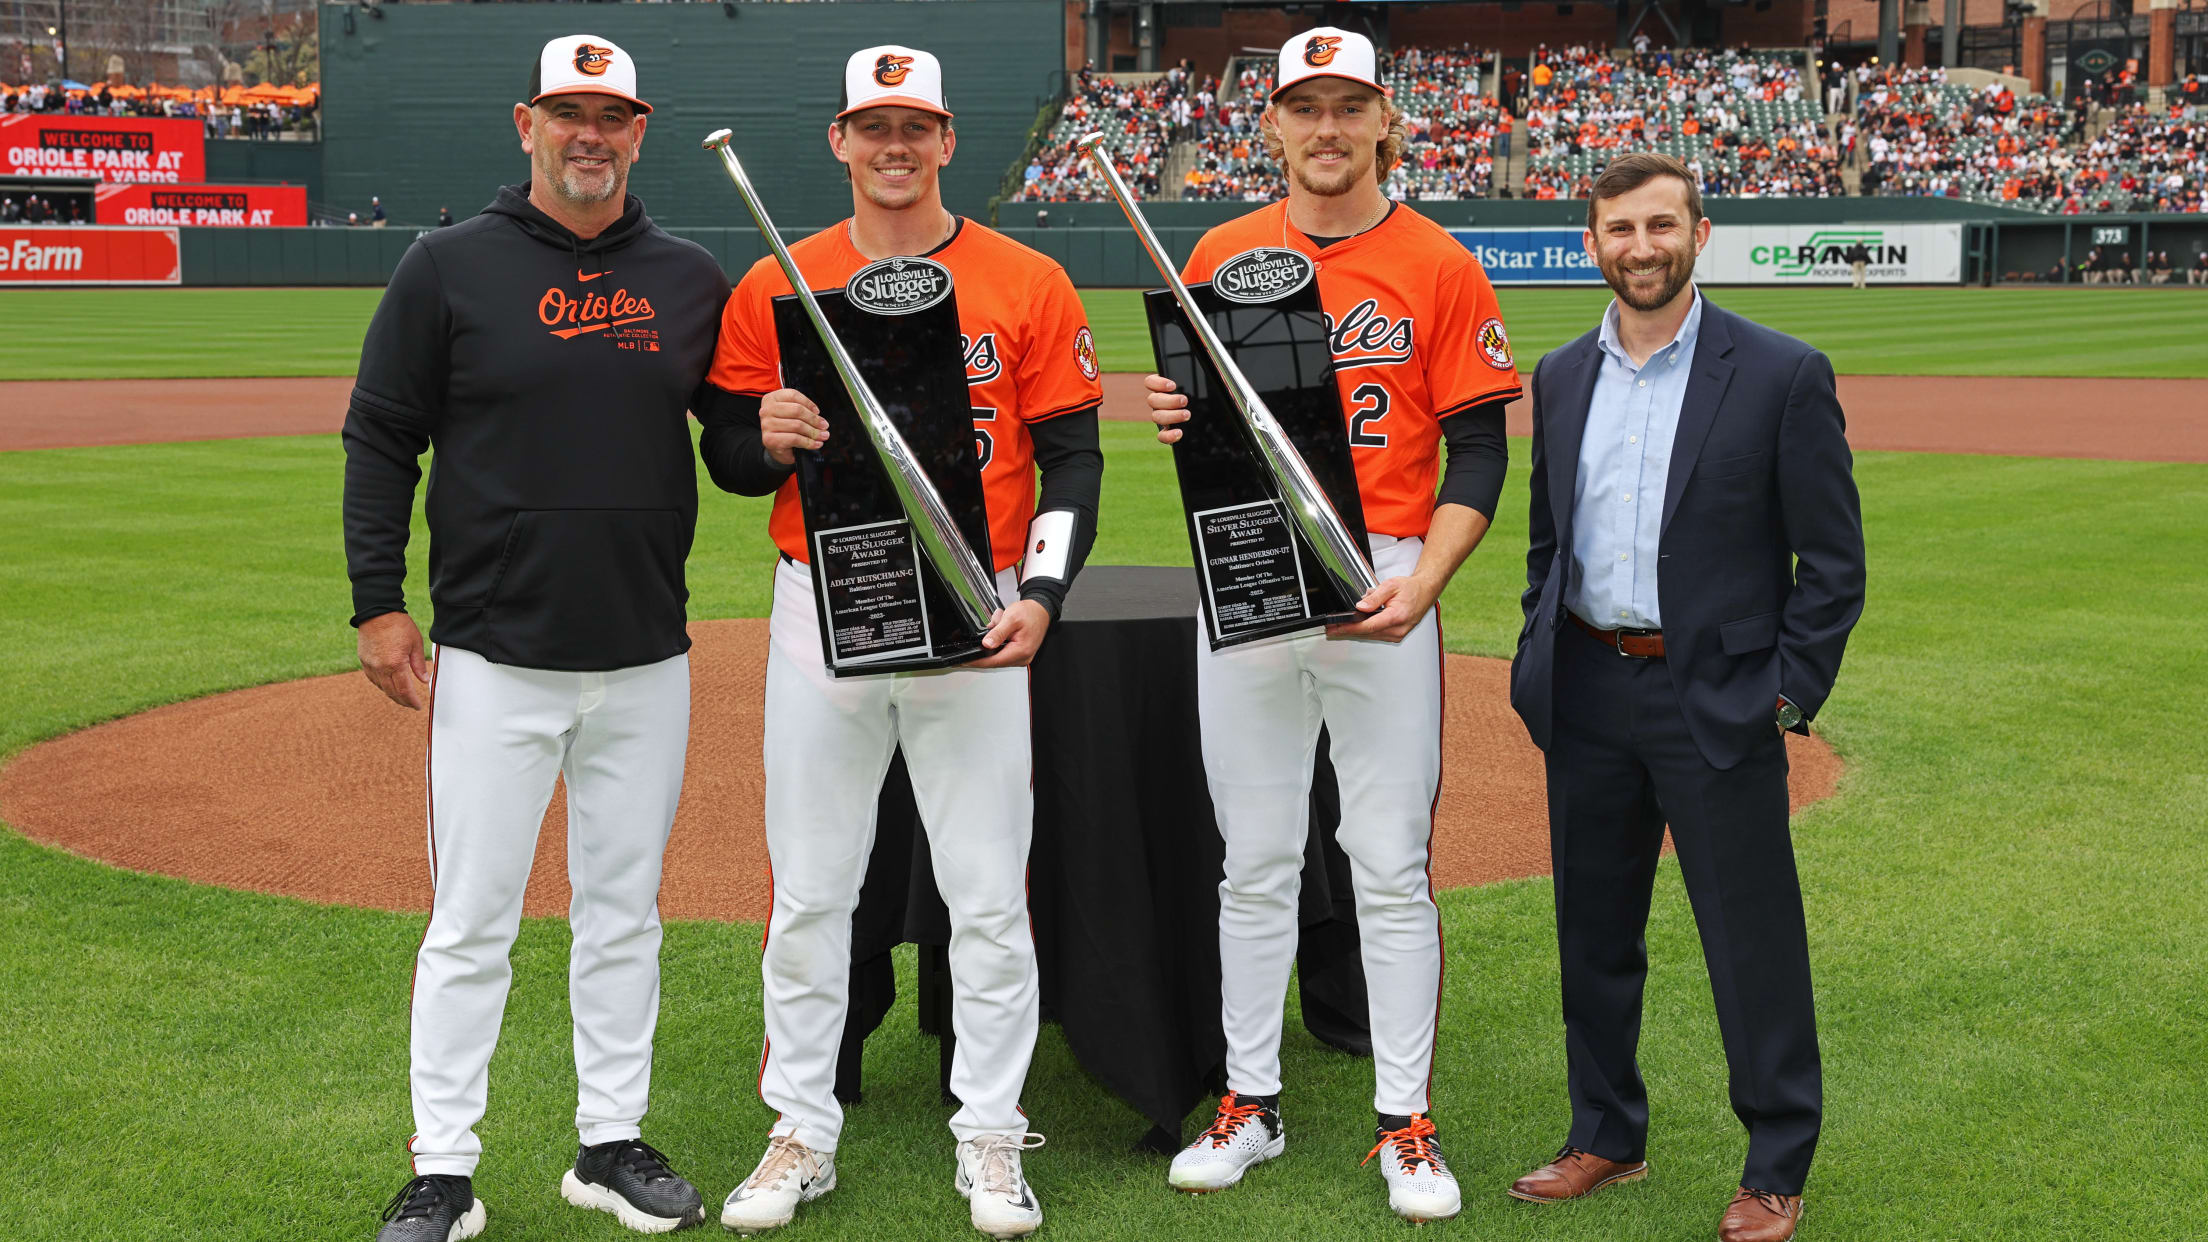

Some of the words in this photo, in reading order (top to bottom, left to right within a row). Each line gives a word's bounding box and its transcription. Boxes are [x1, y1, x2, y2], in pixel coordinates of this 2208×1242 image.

[44, 132, 124, 147] WELCOME
[129, 135, 149, 149] TO
[8, 147, 87, 167] ORIOLE
[93, 149, 150, 169] PARK
[156, 151, 183, 170] AT
[155, 194, 224, 207] WELCOME
[227, 195, 245, 207] TO
[124, 208, 192, 225] ORIOLE
[196, 208, 245, 225] PARK
[250, 209, 274, 225] AT
[2096, 229, 2122, 245] 373
[1750, 246, 1790, 265] CP
[1243, 257, 1296, 274] LOUISVILLE
[880, 268, 935, 283] LOUISVILLE
[1226, 265, 1301, 291] Slugger
[861, 275, 940, 303] Slugger
[538, 287, 655, 326] Orioles
[617, 342, 635, 350] MLB
[1349, 383, 1391, 448] 2
[1217, 513, 1246, 523] LOUISVILLE
[1246, 509, 1271, 518] SLUGGER
[1206, 523, 1239, 534] SILVER
[1239, 516, 1280, 530] SLUGGER
[839, 534, 869, 543] LOUISVILLE
[870, 530, 896, 538] SLUGGER
[1229, 528, 1263, 540] AWARD
[828, 543, 861, 555] SILVER
[861, 537, 904, 550] SLUGGER
[851, 549, 886, 560] AWARD
[1209, 555, 1239, 566] GUNNAR
[1238, 546, 1290, 561] HENDERSON-UT
[851, 560, 880, 568] PRESENTED
[1228, 562, 1255, 571] Baltimore
[1255, 558, 1275, 567] Orioles
[830, 577, 856, 588] ADLEY
[856, 568, 914, 584] RUTSCHMAN-C
[1235, 574, 1255, 583] Member
[1255, 571, 1263, 579] Of
[849, 584, 876, 593] Baltimore
[876, 581, 897, 589] Orioles
[1216, 584, 1240, 593] American
[1240, 581, 1258, 589] League
[834, 607, 860, 615] American
[878, 600, 902, 609] Offensive
[855, 597, 877, 605] Member
